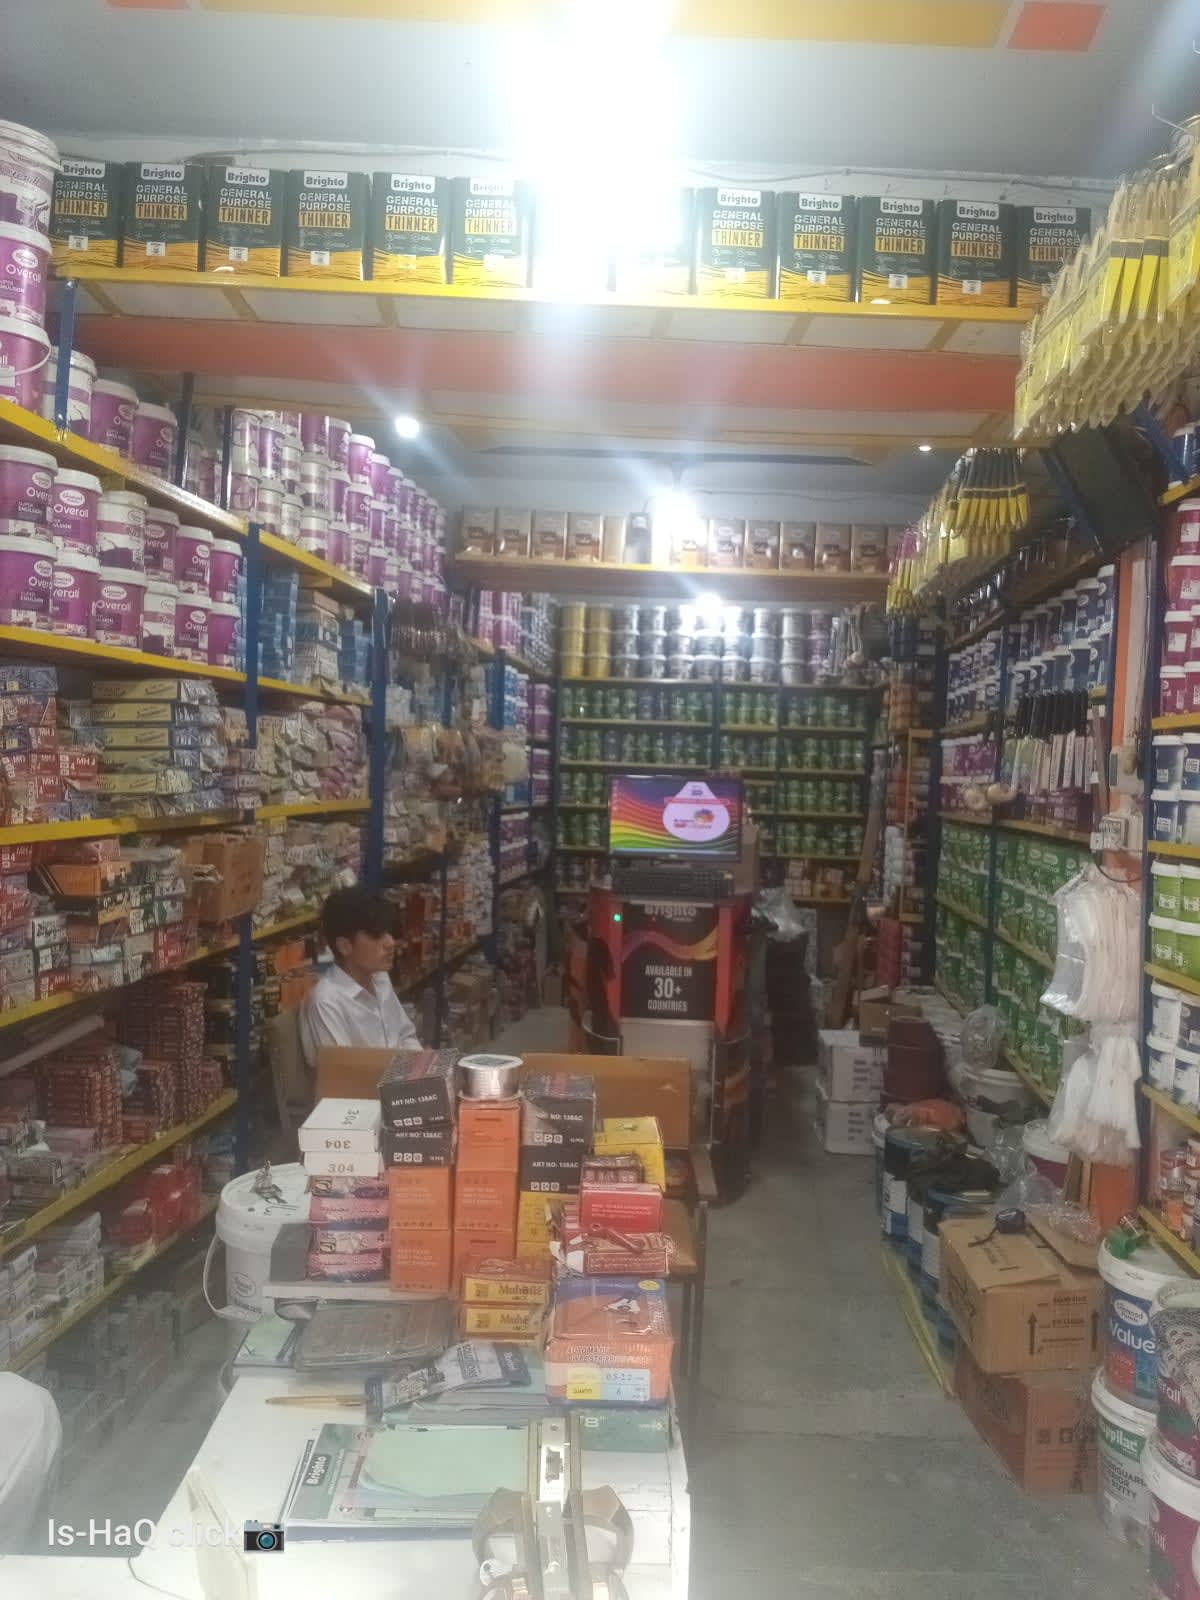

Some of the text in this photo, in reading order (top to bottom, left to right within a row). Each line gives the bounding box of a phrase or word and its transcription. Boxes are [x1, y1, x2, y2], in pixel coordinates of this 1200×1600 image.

[63, 164, 102, 175] Brighto
[143, 167, 181, 178] Brighto
[227, 171, 266, 183] Brighto
[306, 176, 345, 187] Brighto
[55, 181, 107, 191] GENERAL
[136, 185, 188, 195] GENERAL
[393, 179, 431, 191] Brighto
[55, 190, 107, 200] PURPOSE
[136, 194, 188, 204] PURPOSE
[220, 188, 271, 200] GENERAL
[300, 193, 351, 203] GENERAL
[720, 192, 758, 205] Brighto
[220, 198, 271, 209] PURPOSE
[300, 202, 351, 212] PURPOSE
[386, 195, 438, 207] GENERAL
[801, 197, 839, 209] Brighto
[882, 201, 920, 213] Brighto
[56, 200, 105, 216] THINNER
[137, 203, 185, 220] THINNER
[386, 205, 437, 216] PURPOSE
[959, 206, 996, 218] Brighto
[221, 207, 269, 224] THINNER
[301, 212, 349, 228] THINNER
[712, 210, 764, 221] GENERAL
[794, 214, 845, 225] GENERAL
[1036, 211, 1073, 223] Brighto
[388, 215, 435, 232] THINNER
[712, 220, 764, 230] PURPOSE
[794, 224, 845, 235] PURPOSE
[876, 218, 926, 229] GENERAL
[952, 222, 1003, 233] GENERAL
[875, 227, 927, 238] PURPOSE
[952, 232, 1003, 242] PURPOSE
[715, 230, 761, 248] THINNER
[796, 235, 843, 251] THINNER
[877, 237, 924, 253] THINNER
[953, 242, 1000, 258] THINNER
[645, 964, 681, 977] AVAILABLE
[654, 977, 682, 999] 30+
[647, 1000, 688, 1012] COUNTRIES
[328, 1163, 354, 1173] 304
[307, 1456, 327, 1485] Brighto
